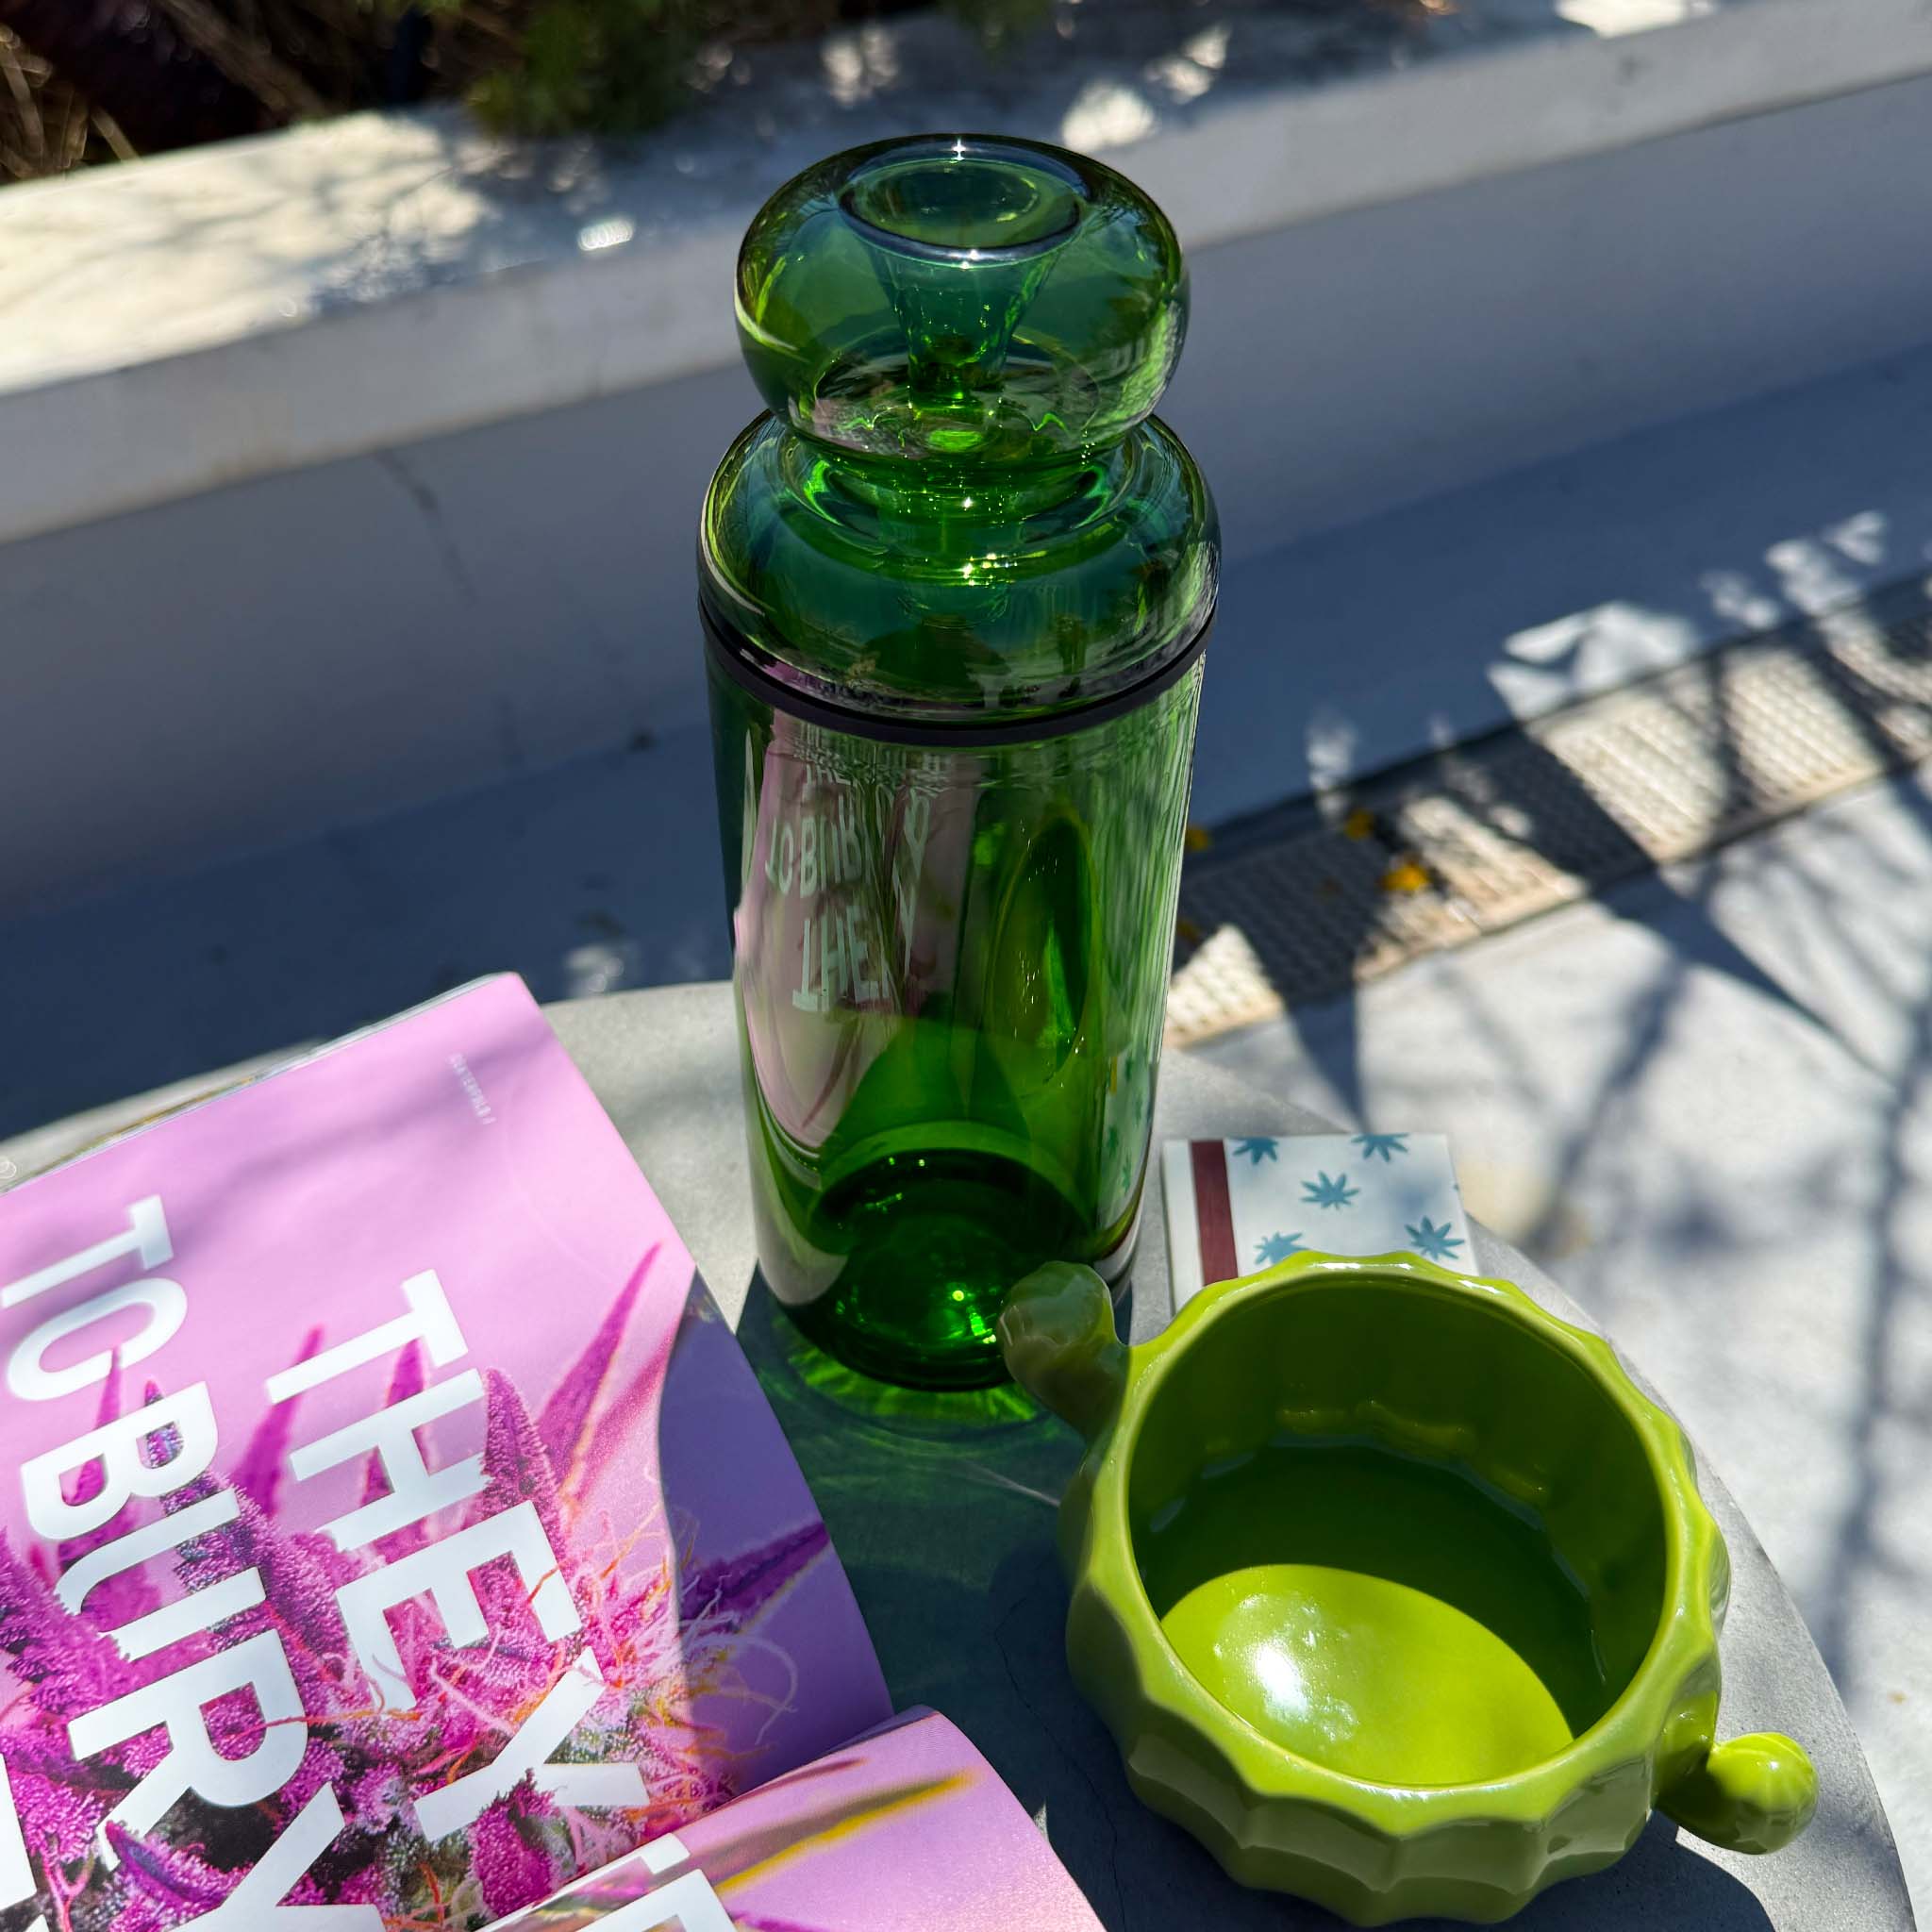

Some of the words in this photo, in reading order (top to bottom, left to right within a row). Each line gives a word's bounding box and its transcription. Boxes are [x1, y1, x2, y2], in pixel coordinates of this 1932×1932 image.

[0, 1194, 188, 1402] TO
[265, 1269, 650, 1841] THEY
[21, 1381, 386, 1932] BURY
